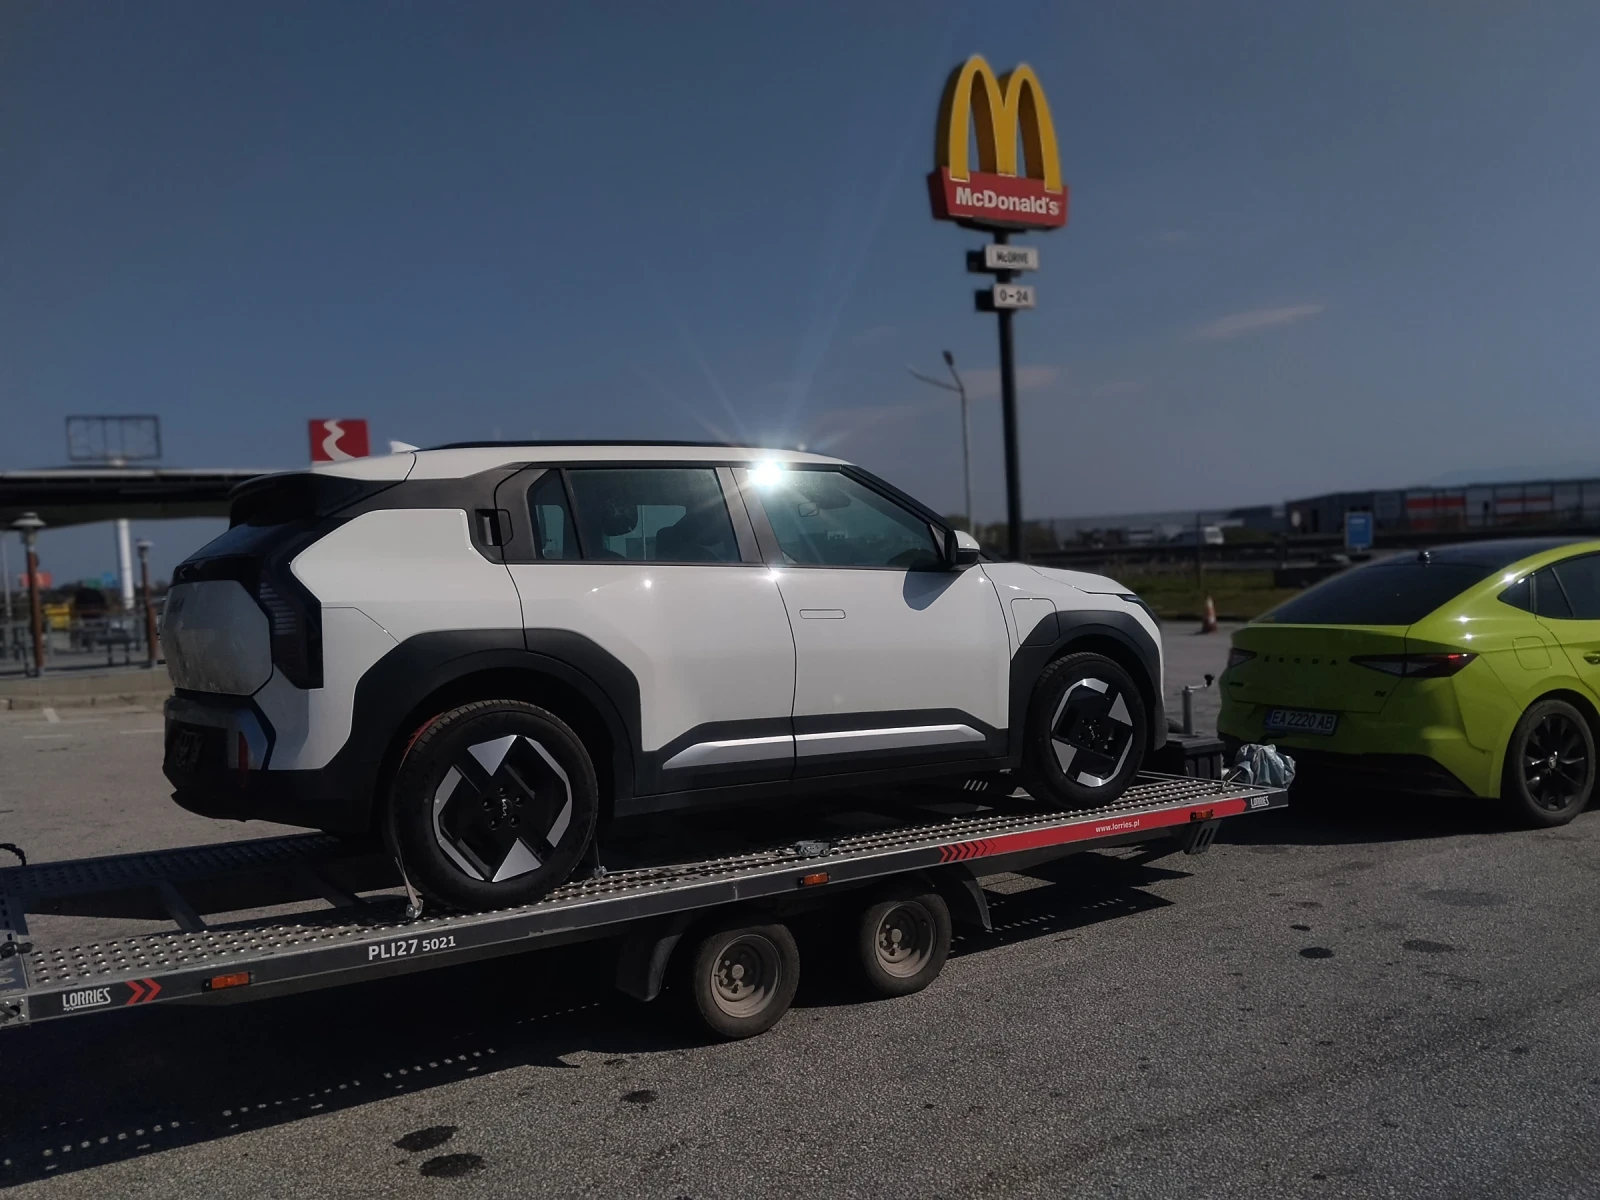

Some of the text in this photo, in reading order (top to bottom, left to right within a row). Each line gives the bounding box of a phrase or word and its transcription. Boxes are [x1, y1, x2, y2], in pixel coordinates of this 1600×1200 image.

[955, 186, 1060, 216] McDonald's
[1271, 711, 1334, 730] EA 2220 AB
[1095, 819, 1140, 833] www.lorries.pl
[368, 935, 456, 961] PLI27 5021
[62, 987, 111, 1011] LORRIES
